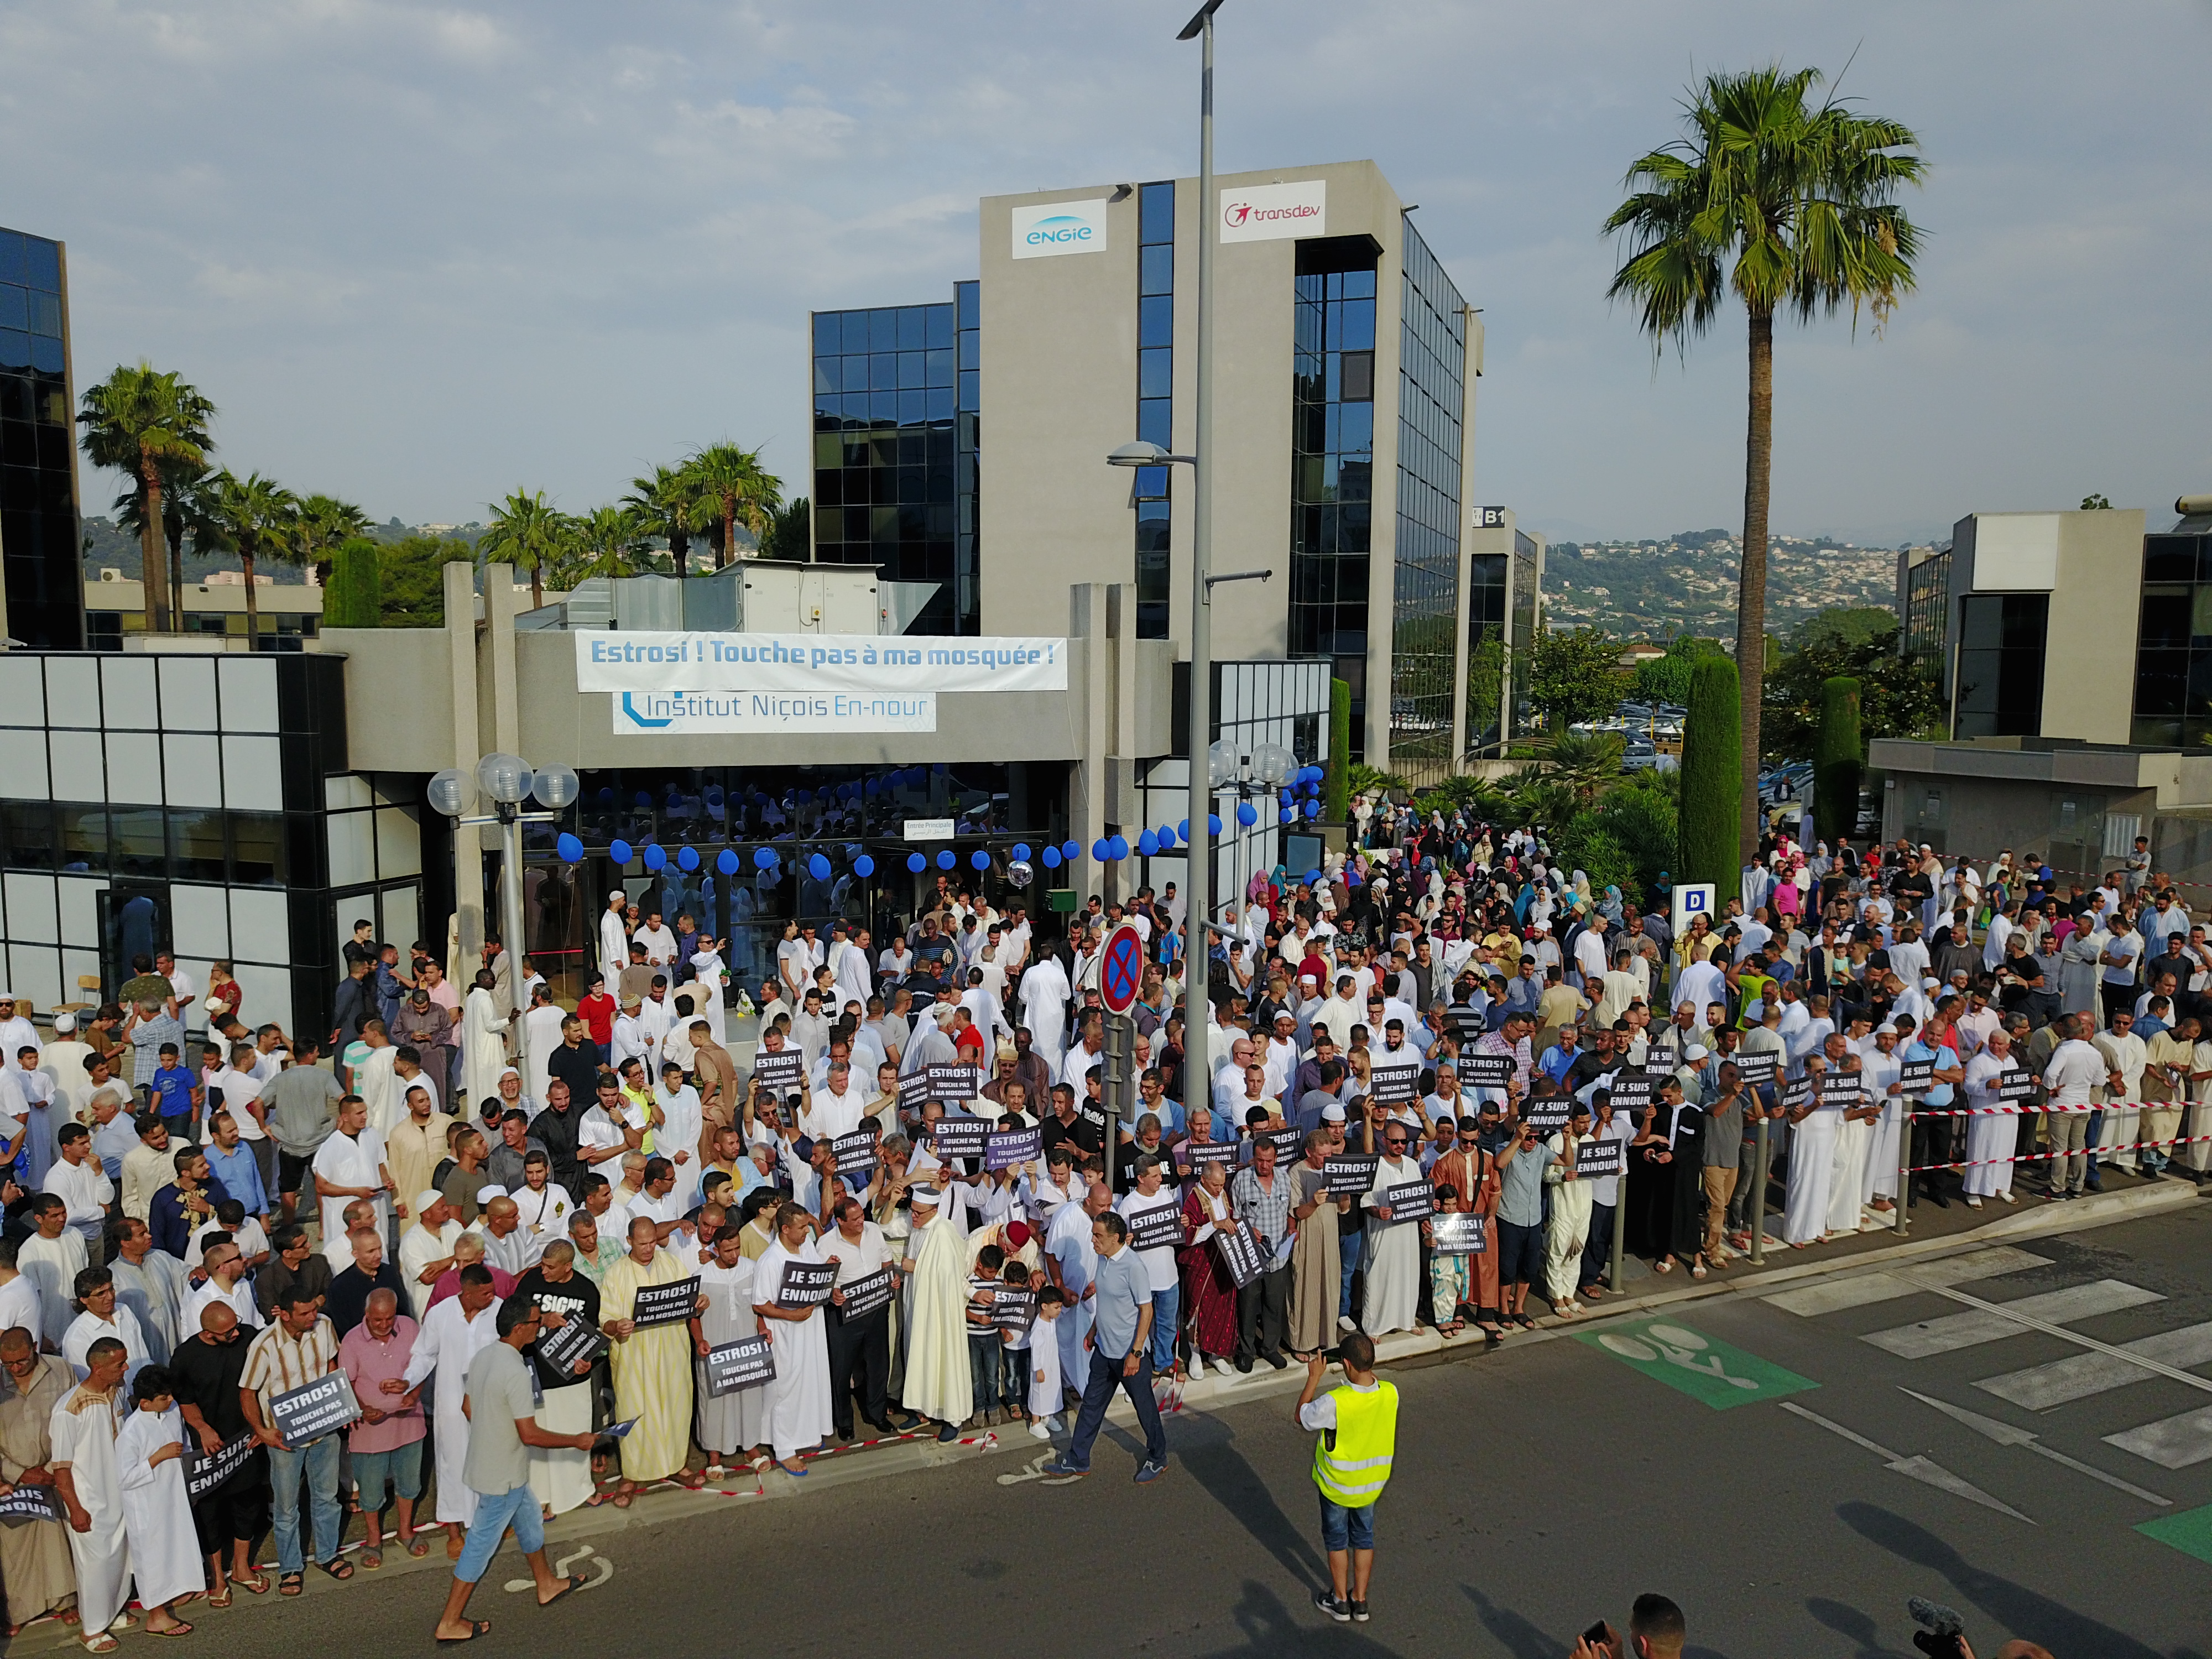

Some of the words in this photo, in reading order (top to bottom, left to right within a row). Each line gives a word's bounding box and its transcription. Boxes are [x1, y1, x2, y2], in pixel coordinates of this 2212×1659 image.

[1254, 205, 1320, 221] transdev
[1485, 510, 1505, 524] B1
[592, 641, 688, 662] Estrosi
[710, 640, 805, 664] Touche
[811, 648, 857, 669] pas
[863, 644, 877, 664] à
[884, 649, 921, 665] ma
[927, 645, 1041, 670] mosquée
[648, 695, 741, 717] Institut
[753, 695, 827, 721] Niçois
[834, 696, 927, 716] En-nour
[1691, 894, 1700, 908] D
[756, 1056, 796, 1068] ESTROSI
[1459, 1058, 1503, 1068] ESTROSI
[1650, 1052, 1660, 1061] JE
[1738, 1055, 1773, 1066] ESTROSI
[929, 1068, 970, 1078] ESTROSI
[1372, 1070, 1411, 1082] ESTROSI
[1903, 1067, 1912, 1077] JE
[1913, 1065, 1931, 1076] SUIS
[899, 1074, 926, 1091] ESTROSI
[1824, 1079, 1835, 1088] JE
[1838, 1077, 1859, 1088] SUIS
[1901, 1077, 1932, 1089] ENNOUR
[2003, 1076, 2012, 1084] JE
[2013, 1073, 2030, 1083] SUIS
[1614, 1083, 1626, 1092] JE
[1627, 1082, 1650, 1092] SUIS
[1787, 1084, 1797, 1093] JE
[2000, 1085, 2031, 1097] ENNOUR
[1610, 1095, 1651, 1106] ENNOUR
[1821, 1090, 1860, 1102] ENNOUR
[1532, 1102, 1545, 1112] JE
[1546, 1102, 1569, 1112] SUIS
[1526, 1115, 1569, 1125] ENNOUR
[936, 1123, 984, 1134] ESTROSI
[832, 1133, 870, 1152] ESTROSI
[989, 1131, 1035, 1146] ESTROSI
[838, 1151, 860, 1161] TOUCHE
[1581, 1148, 1593, 1159] JE
[1595, 1146, 1616, 1157] SUIS
[1325, 1163, 1371, 1173] ESTROSI
[1577, 1160, 1619, 1172] ENNOUR
[1389, 1185, 1427, 1201] ESTROSI
[1396, 1202, 1417, 1210] TOUCHE
[1131, 1209, 1175, 1229] ESTROSI
[1433, 1219, 1477, 1230] ESROSI
[1140, 1228, 1163, 1238] TOUCHE
[1163, 1224, 1175, 1232] PAS
[1237, 1220, 1260, 1269] ESTROSI
[788, 1270, 805, 1284] JE
[807, 1271, 834, 1284] SUIS
[842, 1273, 889, 1299] ESTROSI
[638, 1284, 691, 1302] ESTROSI
[781, 1287, 832, 1302] ENNOUR
[851, 1291, 876, 1307] TOUCHE
[876, 1287, 888, 1297] PAS
[994, 1291, 1029, 1303] ESTROSI
[645, 1303, 674, 1313] TOUCHE
[675, 1299, 688, 1307] PAS
[541, 1318, 578, 1358] ESTROSI
[709, 1342, 763, 1365] ESTROSI
[721, 1363, 749, 1376] TOUCHE
[749, 1359, 764, 1370] PAS
[273, 1381, 338, 1417] ESTROSI
[289, 1405, 325, 1427] TOUCHE
[325, 1399, 342, 1412] PAS
[193, 1457, 212, 1474] JE
[217, 1433, 251, 1464] SUIS
[190, 1448, 253, 1494] ENNOUR
